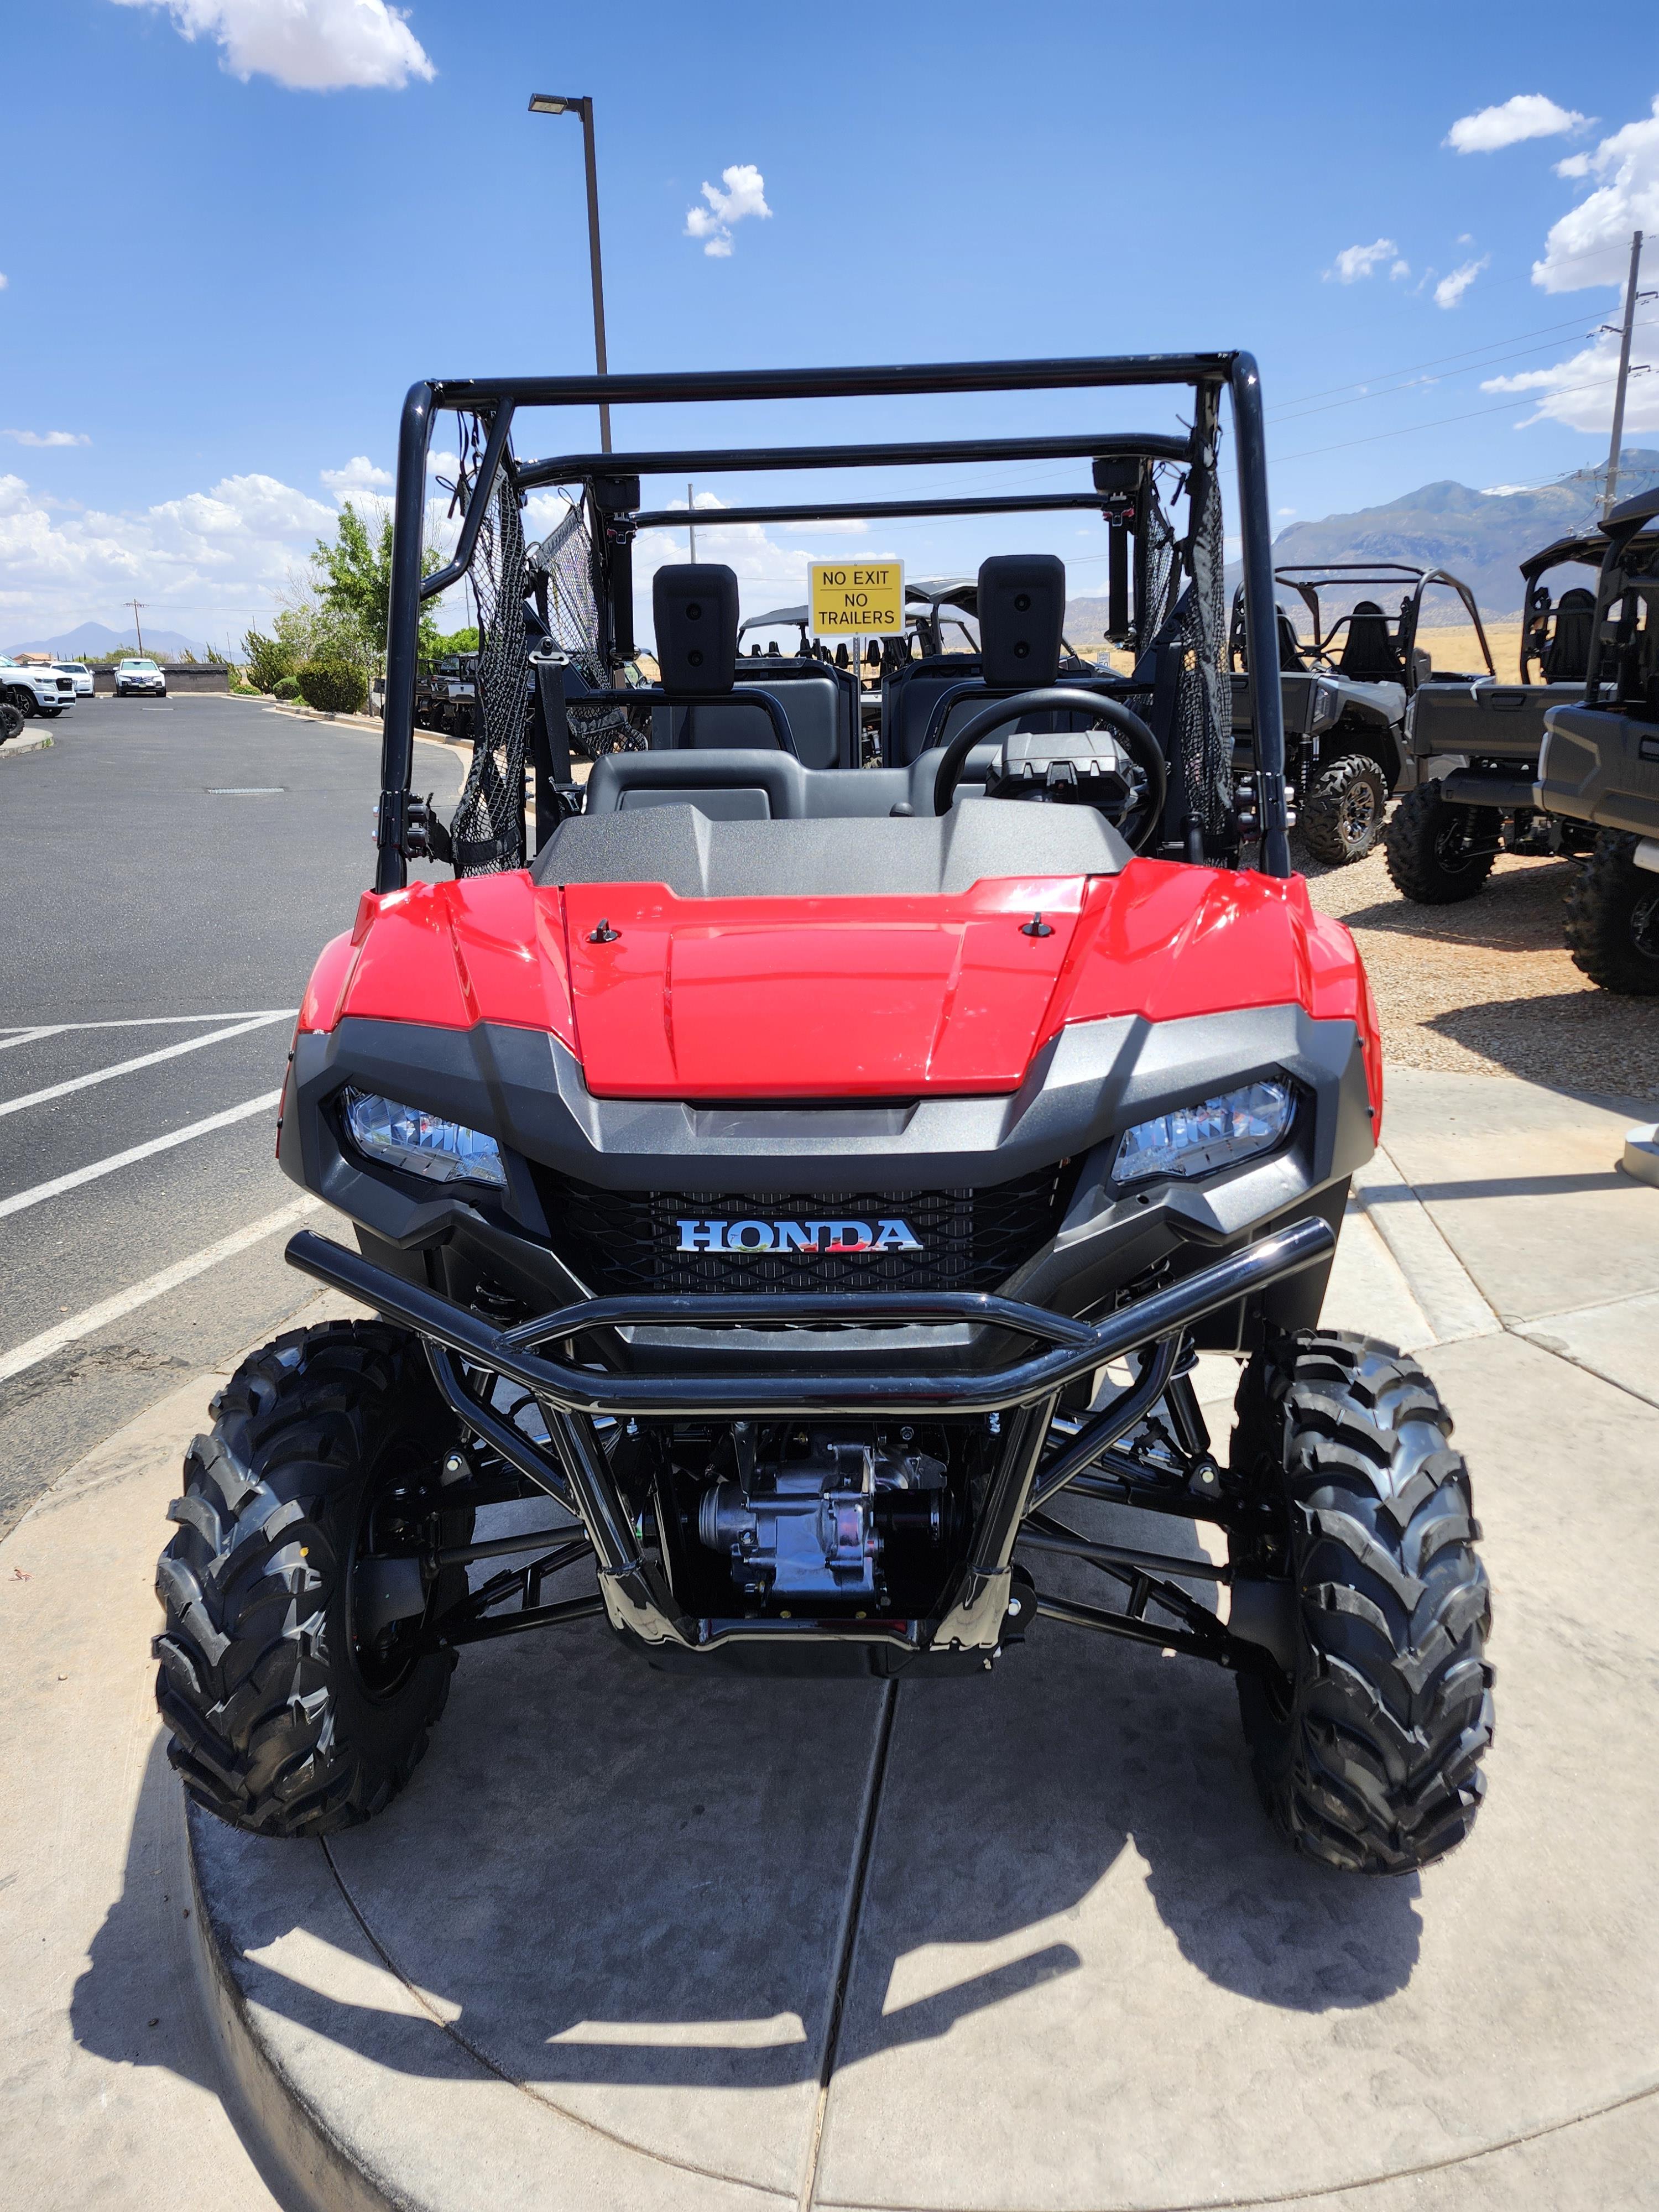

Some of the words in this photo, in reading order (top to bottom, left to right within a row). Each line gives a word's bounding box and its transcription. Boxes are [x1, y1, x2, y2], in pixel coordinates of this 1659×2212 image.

[823, 571, 846, 585] NO
[854, 571, 889, 585] EXIT
[844, 593, 868, 607] NO
[818, 610, 895, 625] TRAILERS
[676, 1219, 924, 1253] HONDA
